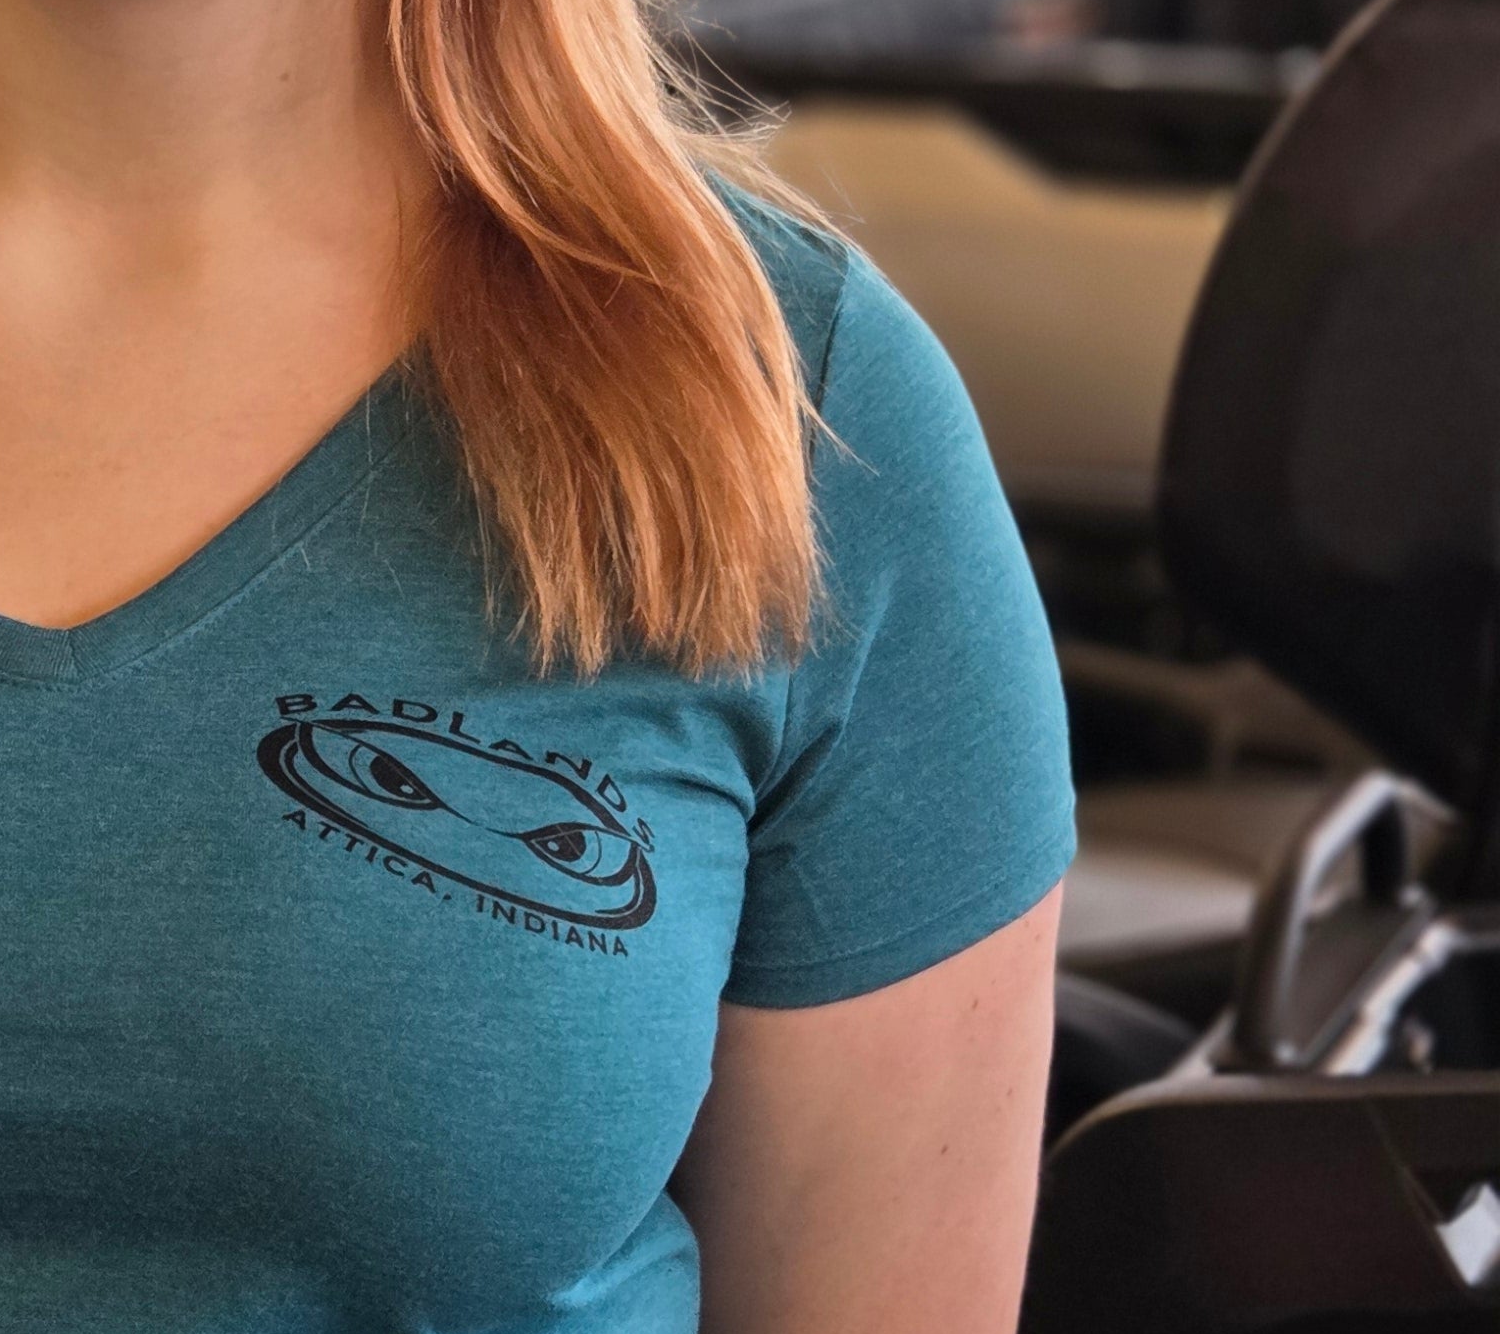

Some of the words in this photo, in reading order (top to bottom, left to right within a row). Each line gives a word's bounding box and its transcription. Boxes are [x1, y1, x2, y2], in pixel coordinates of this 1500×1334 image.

[275, 693, 656, 854] BADLANDS
[282, 809, 452, 901] ATTICA,
[476, 893, 629, 957] INDIANA
